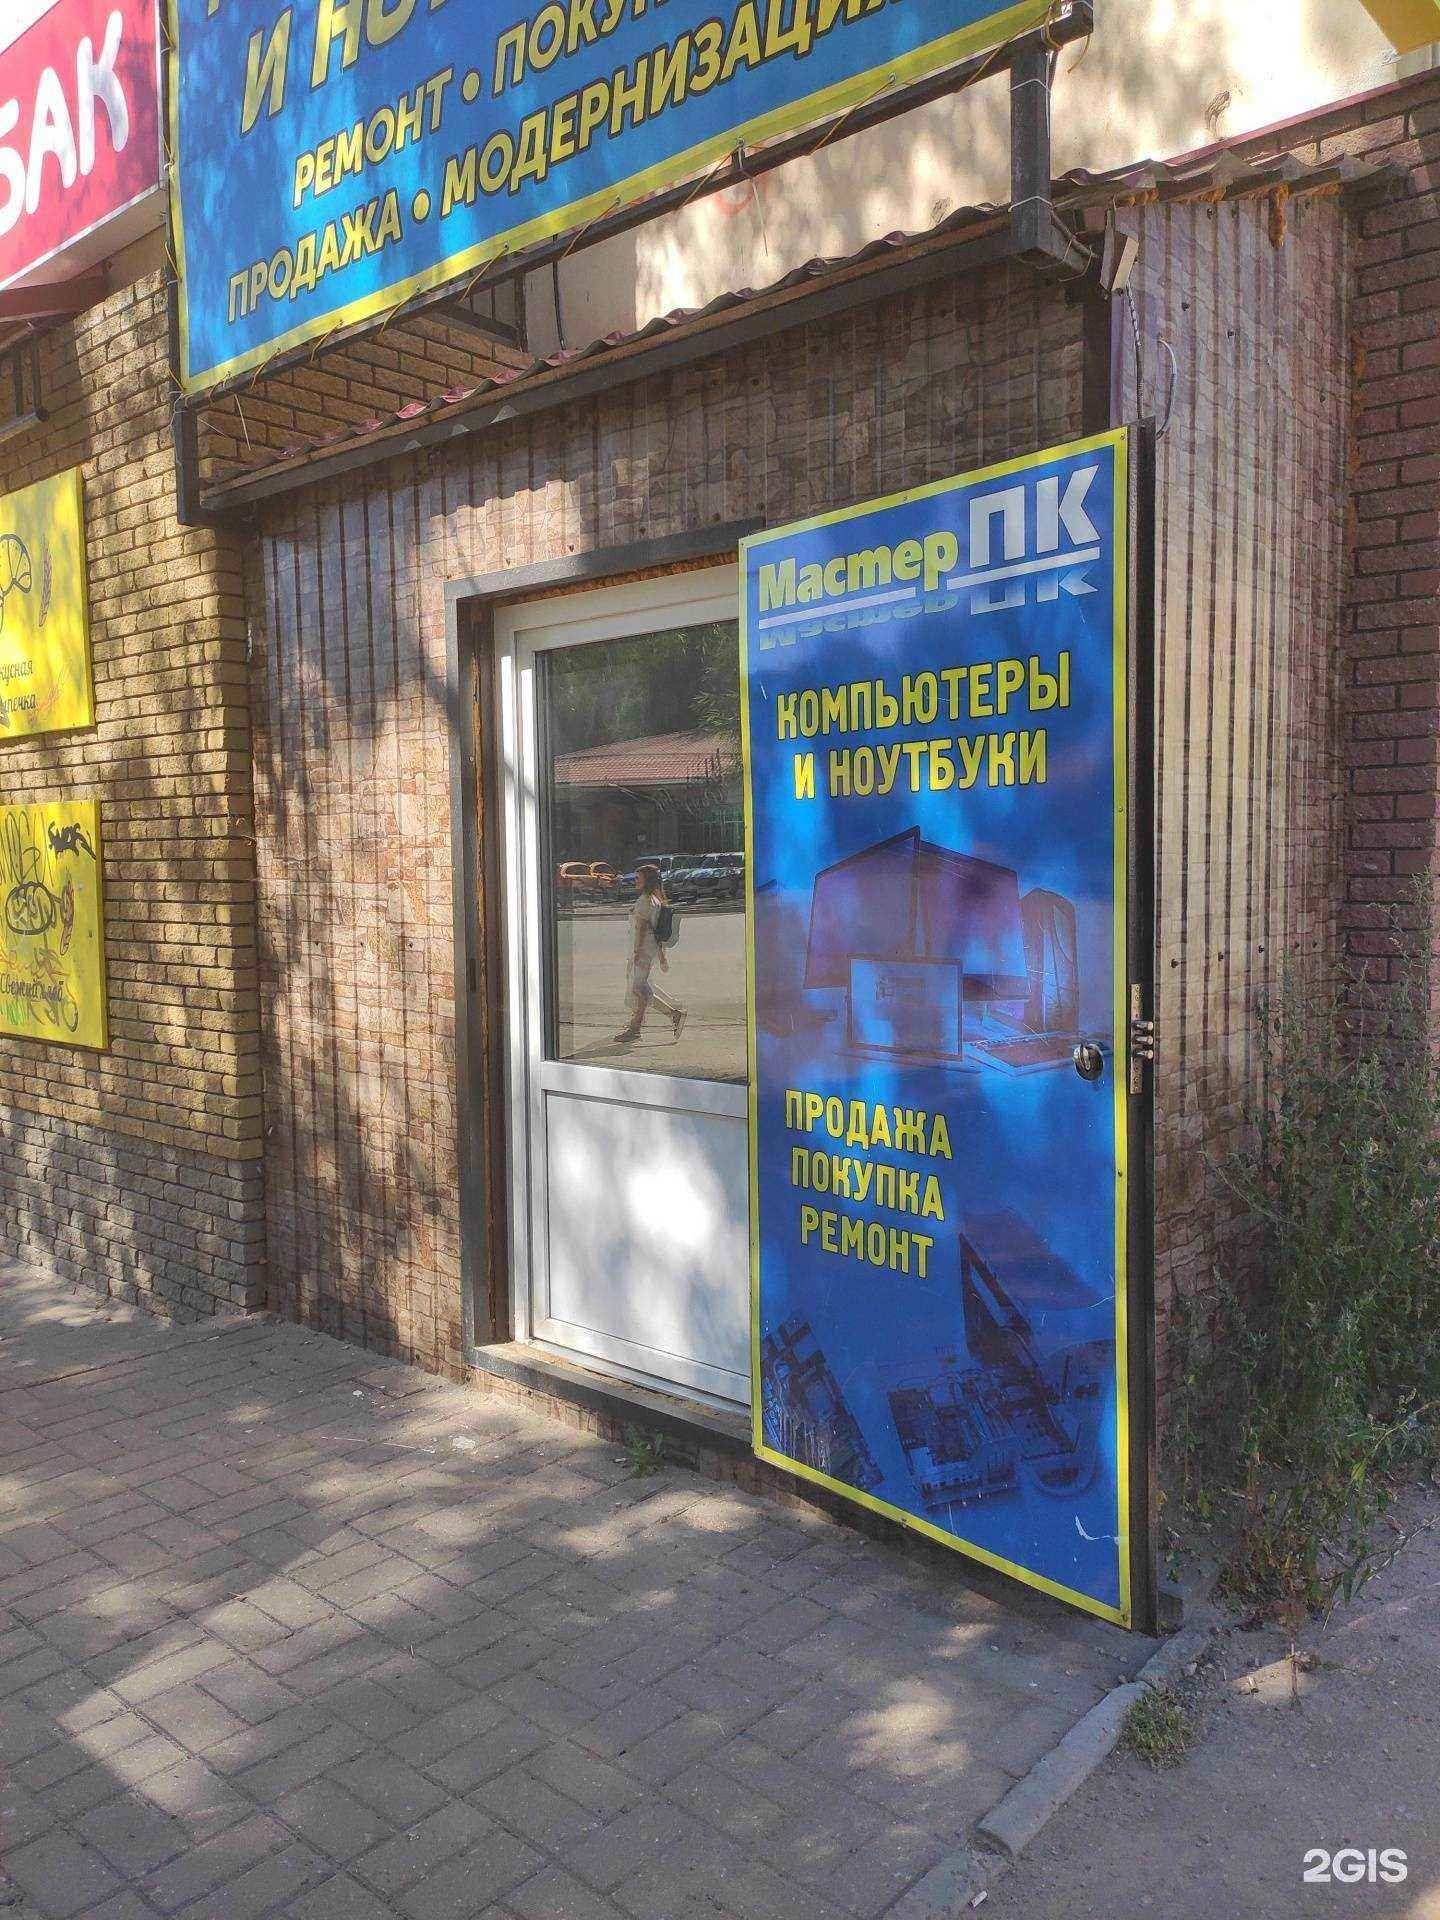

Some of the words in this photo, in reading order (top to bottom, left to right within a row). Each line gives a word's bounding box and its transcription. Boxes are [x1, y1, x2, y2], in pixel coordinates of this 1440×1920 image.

[292, 66, 454, 210] РЕМОНТ
[227, 188, 402, 324] ПРОДАЖА
[758, 530, 960, 613] Мастер
[969, 463, 1102, 569] ПК
[776, 650, 1072, 741] КОМПЬЮТЕРЫ
[793, 750, 816, 800] И
[828, 729, 1049, 798] НОУТБУКИ
[785, 1088, 953, 1160] ПРОДАЖА
[791, 1146, 945, 1222] ПОКУПКА
[799, 1205, 934, 1279] РЕМОНТ
